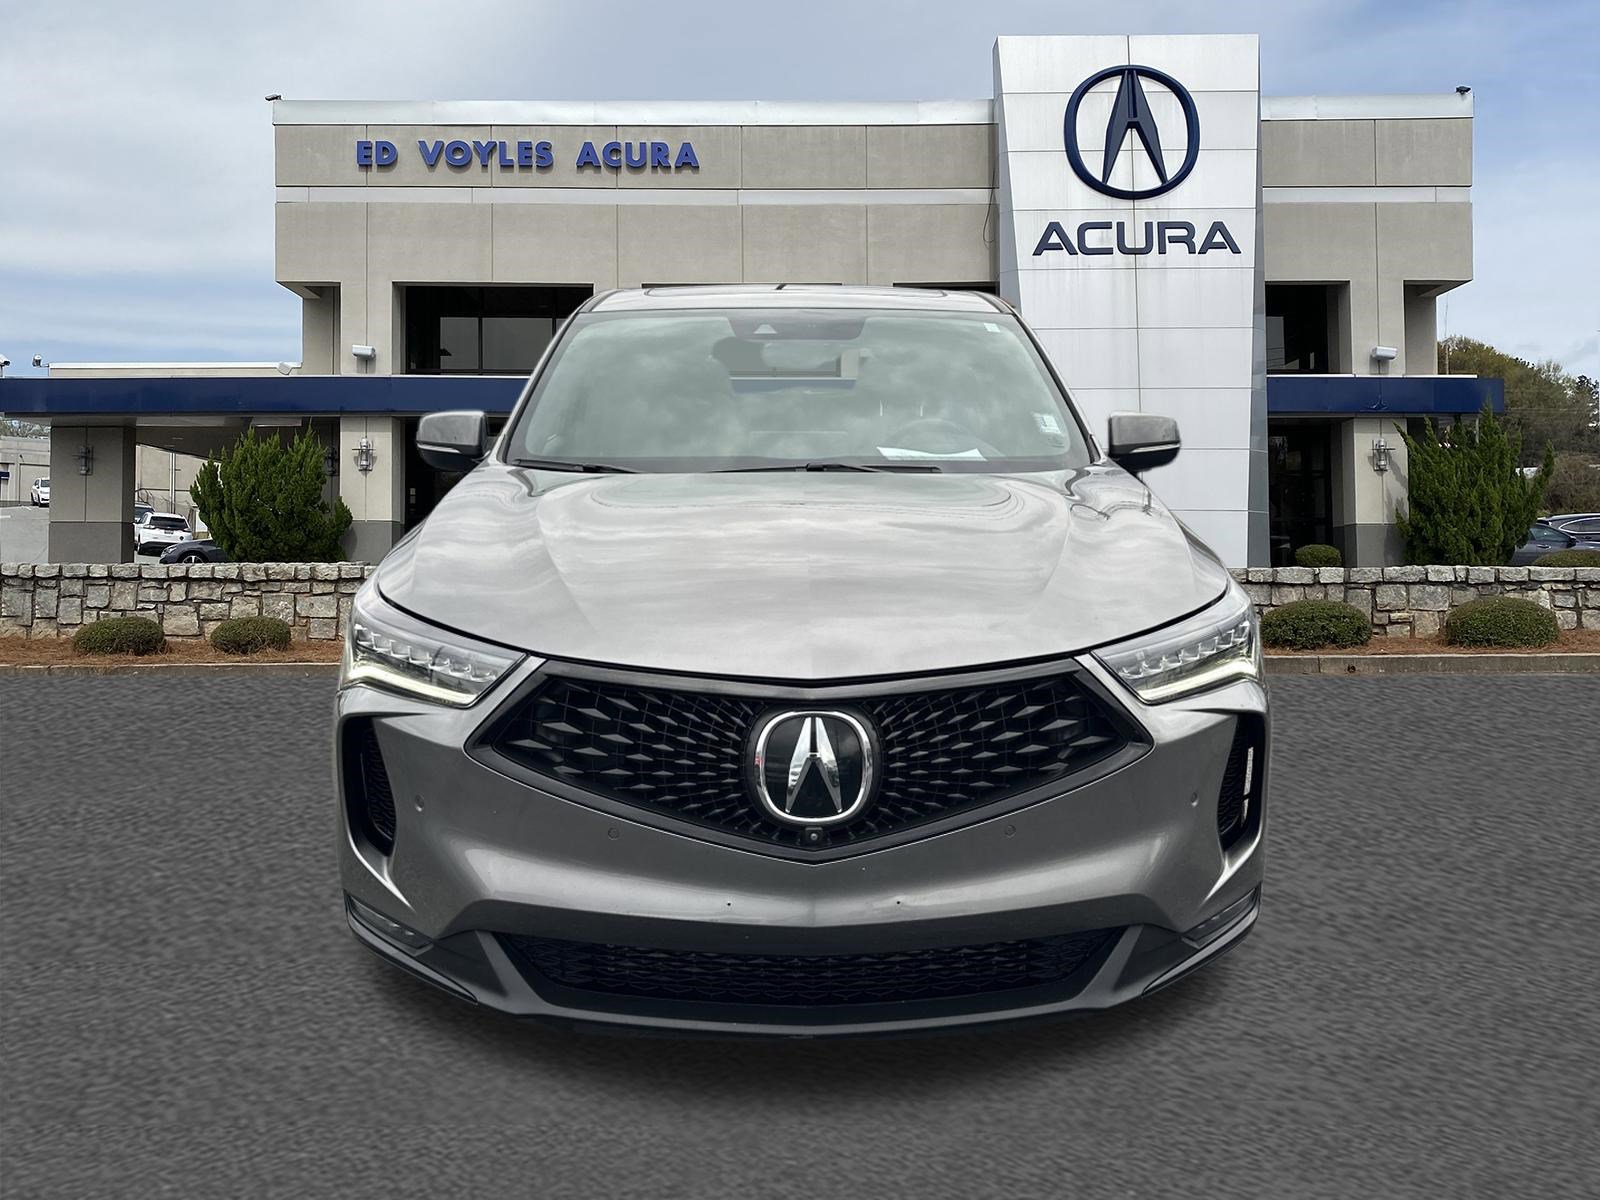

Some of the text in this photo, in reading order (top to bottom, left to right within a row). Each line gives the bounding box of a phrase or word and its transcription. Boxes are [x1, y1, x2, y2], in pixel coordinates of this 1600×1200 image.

[356, 140, 700, 169] ED VOYLES ACURA
[1033, 221, 1241, 256] ACURA
